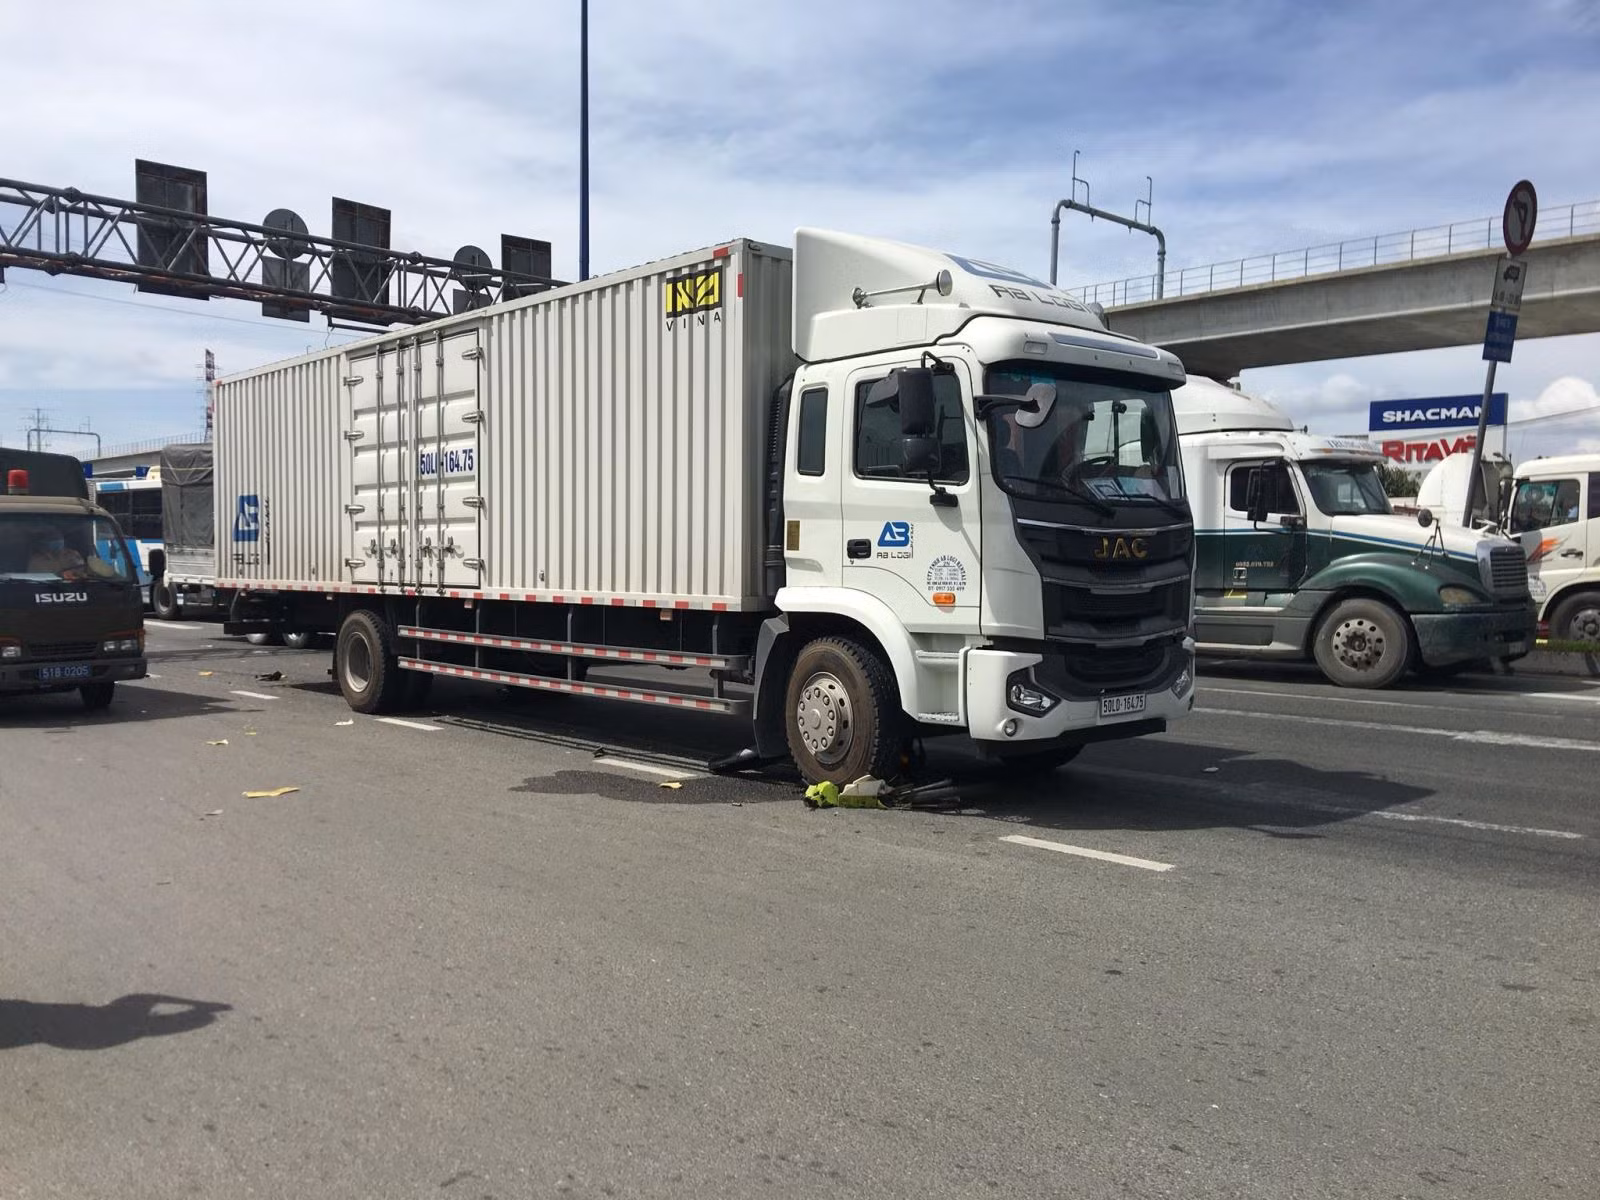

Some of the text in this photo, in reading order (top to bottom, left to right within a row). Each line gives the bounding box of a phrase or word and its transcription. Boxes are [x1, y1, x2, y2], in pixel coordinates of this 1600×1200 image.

[666, 311, 721, 331] VINA
[1095, 537, 1149, 559] JAC
[35, 592, 88, 603] ISUZU
